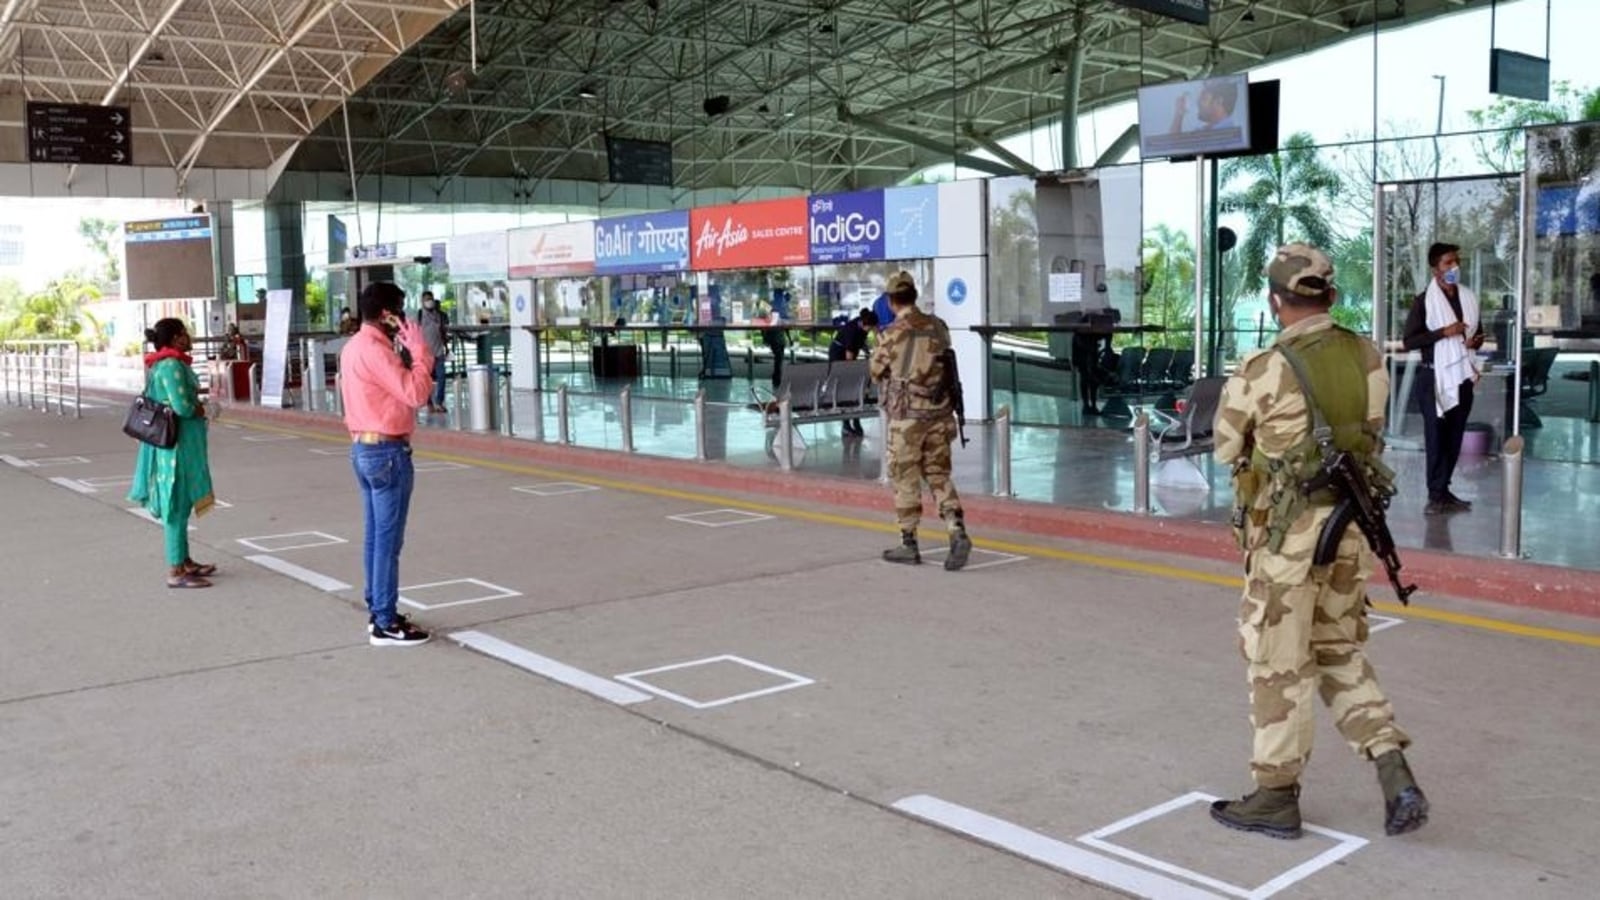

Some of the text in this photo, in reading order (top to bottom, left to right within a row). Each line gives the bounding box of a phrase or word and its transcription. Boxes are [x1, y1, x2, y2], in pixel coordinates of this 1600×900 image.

[596, 223, 633, 257] GoAir
[752, 229, 774, 239] SALES
[775, 226, 804, 237] CENTRE
[811, 212, 880, 244] IndiGo
